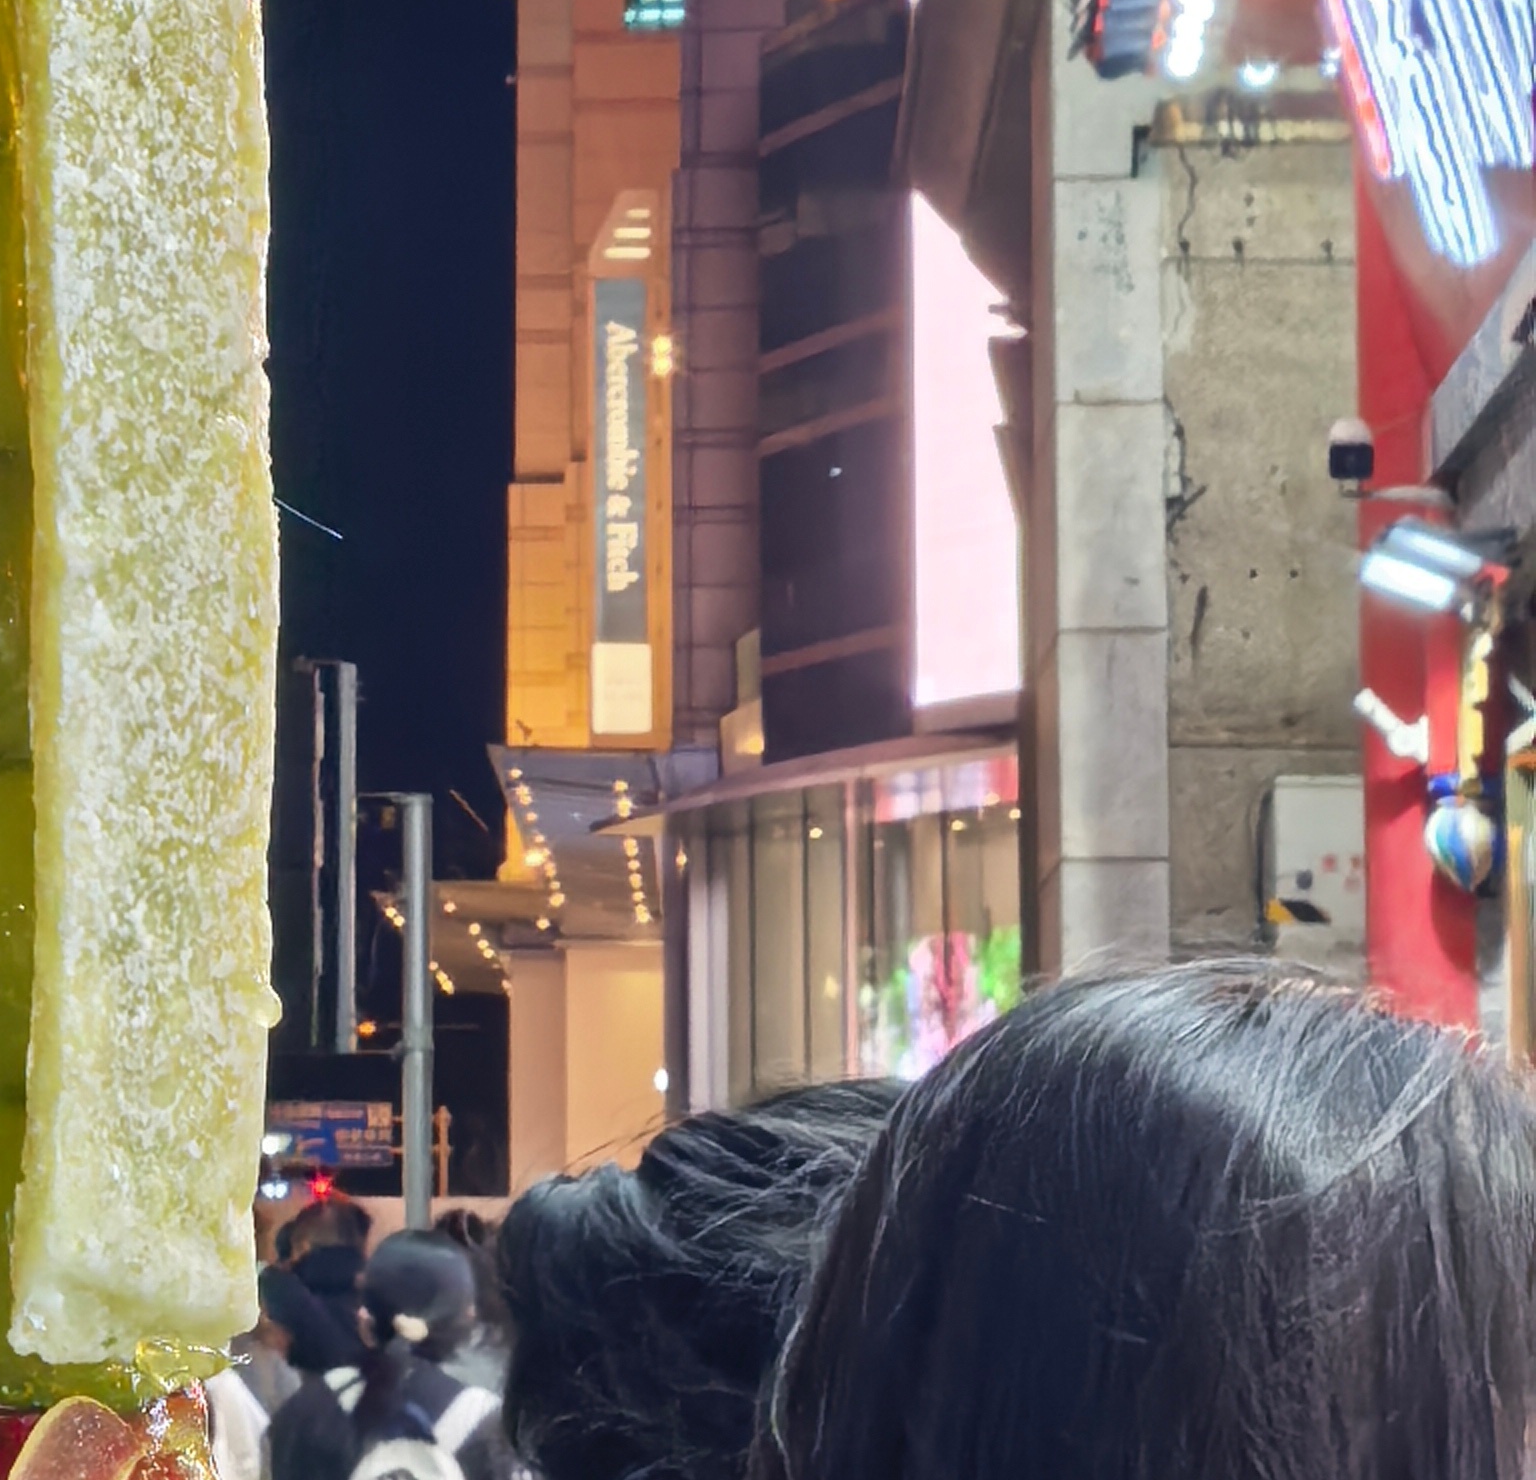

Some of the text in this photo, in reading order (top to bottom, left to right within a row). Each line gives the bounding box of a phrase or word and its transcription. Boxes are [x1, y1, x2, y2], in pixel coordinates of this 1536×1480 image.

[605, 320, 640, 593] Abercrombie & Fitch
